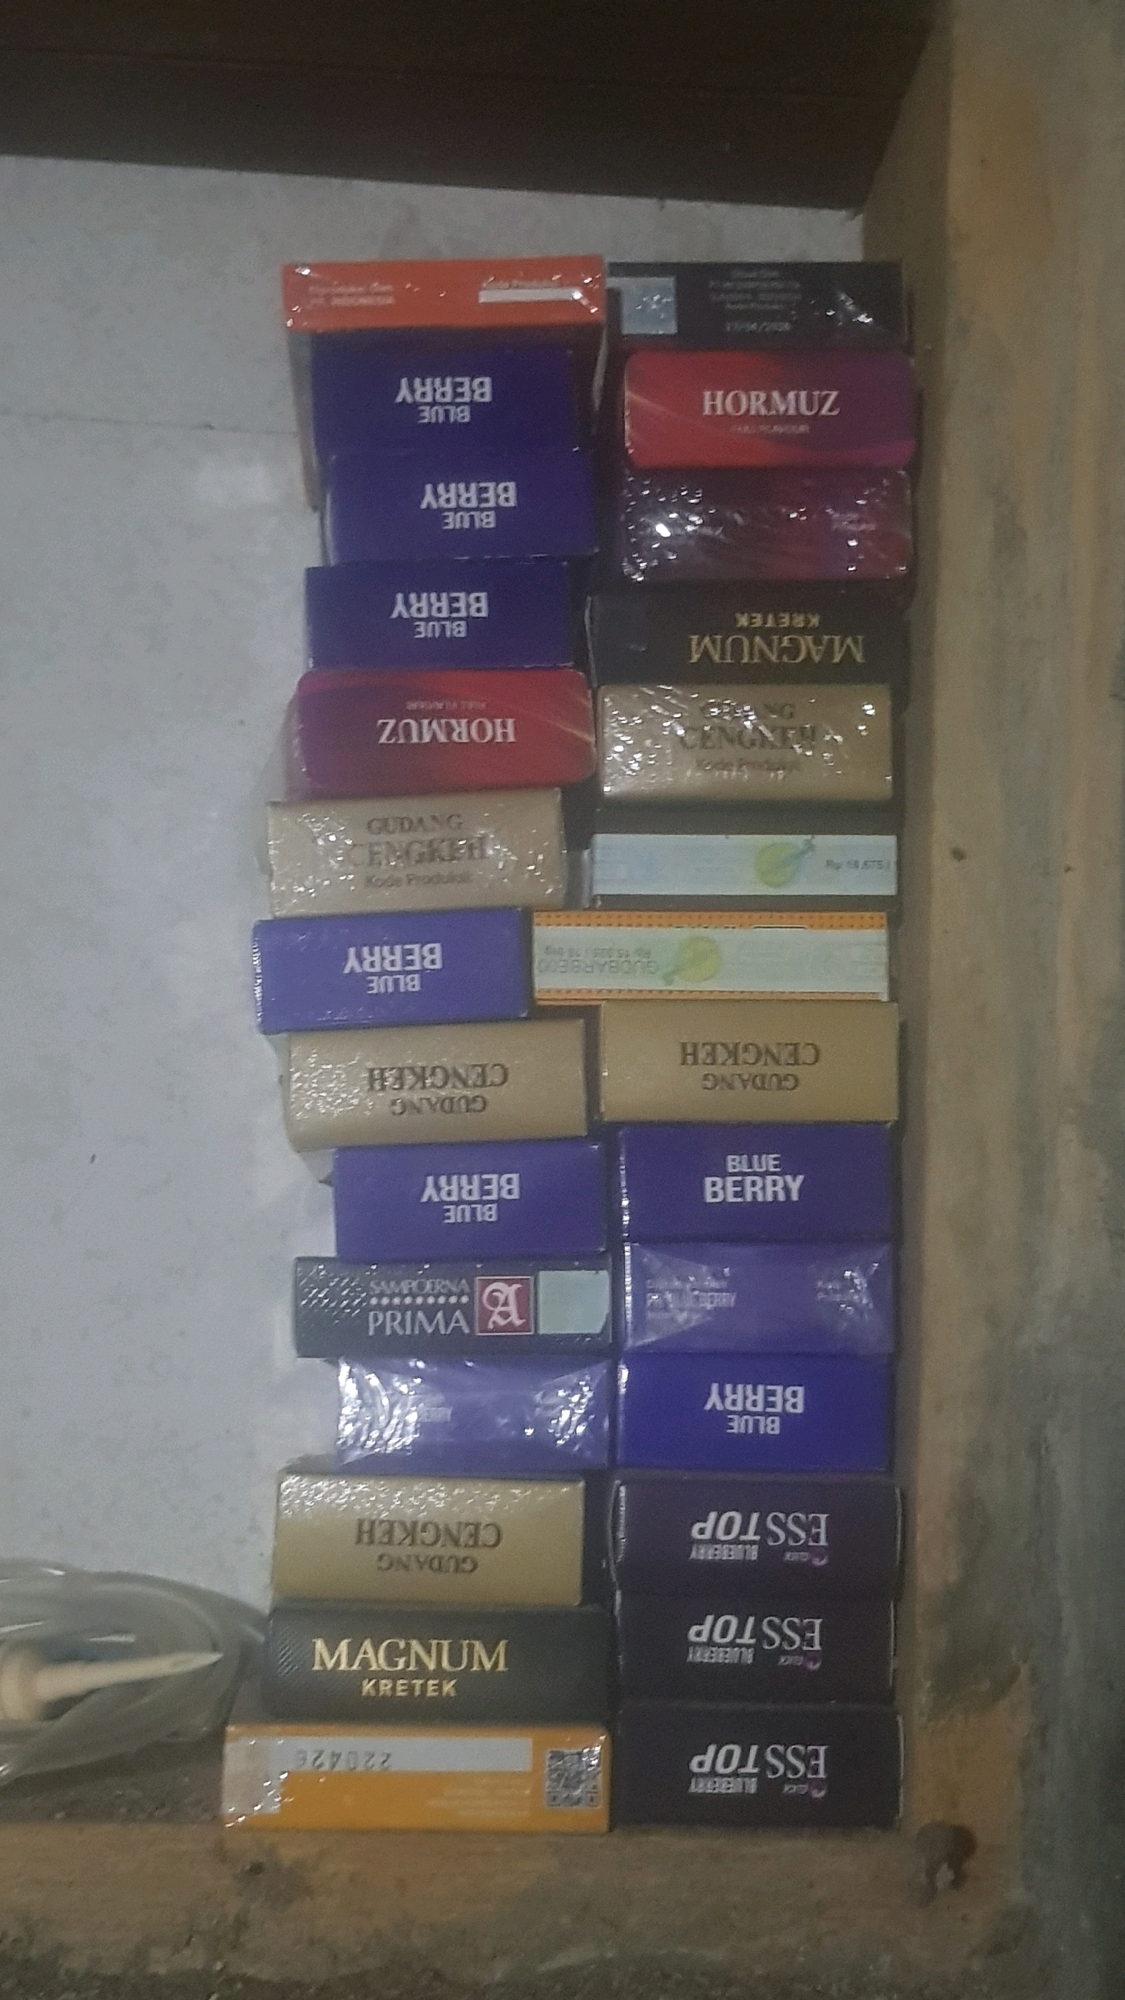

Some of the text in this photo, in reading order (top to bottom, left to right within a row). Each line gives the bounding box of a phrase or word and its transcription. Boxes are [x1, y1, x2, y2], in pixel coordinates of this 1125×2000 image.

[396, 377, 492, 402] BERRY
[418, 405, 469, 422] BLUE
[703, 390, 839, 417] HORMUZ
[421, 483, 515, 507] BERRY
[442, 511, 495, 529] BLUE
[392, 592, 487, 617] BERRY
[414, 621, 466, 638] BLUE
[736, 613, 819, 628] KRETEK
[690, 635, 864, 663] MAGNUM
[379, 718, 515, 743] HORMUZ
[680, 727, 817, 750] CENGKEH
[367, 813, 464, 834] GUDANG
[343, 943, 441, 974] BERRY
[367, 975, 419, 993] BLUE
[679, 1042, 819, 1066] CENGKEH
[366, 1065, 508, 1093] CENGKEH
[701, 1073, 798, 1092] GUDANG
[391, 1096, 486, 1116] GUDANG
[728, 1154, 780, 1173] BLUE
[422, 1174, 520, 1203] BERRY
[706, 1176, 805, 1203] BERRY
[443, 1204, 497, 1223] BLUE
[370, 1279, 469, 1295] SAMPOERNA
[368, 1310, 469, 1336] PRIMA
[706, 1384, 804, 1411] BERRY
[727, 1415, 780, 1434] BLUE
[356, 1519, 500, 1547] CENGKEH
[691, 1511, 829, 1546] ESS TOP
[378, 1552, 477, 1574] GUDANG
[688, 1544, 759, 1561] BLUEBERRY
[687, 1615, 823, 1650] ESS TOP
[312, 1638, 508, 1671] MAGNUM
[687, 1647, 754, 1664] BLUEBERRY
[361, 1680, 457, 1697] KRETEK
[294, 1749, 393, 1771] 220426
[689, 1744, 828, 1778] ESS TOP
[688, 1778, 758, 1794] BLUEBERRY
